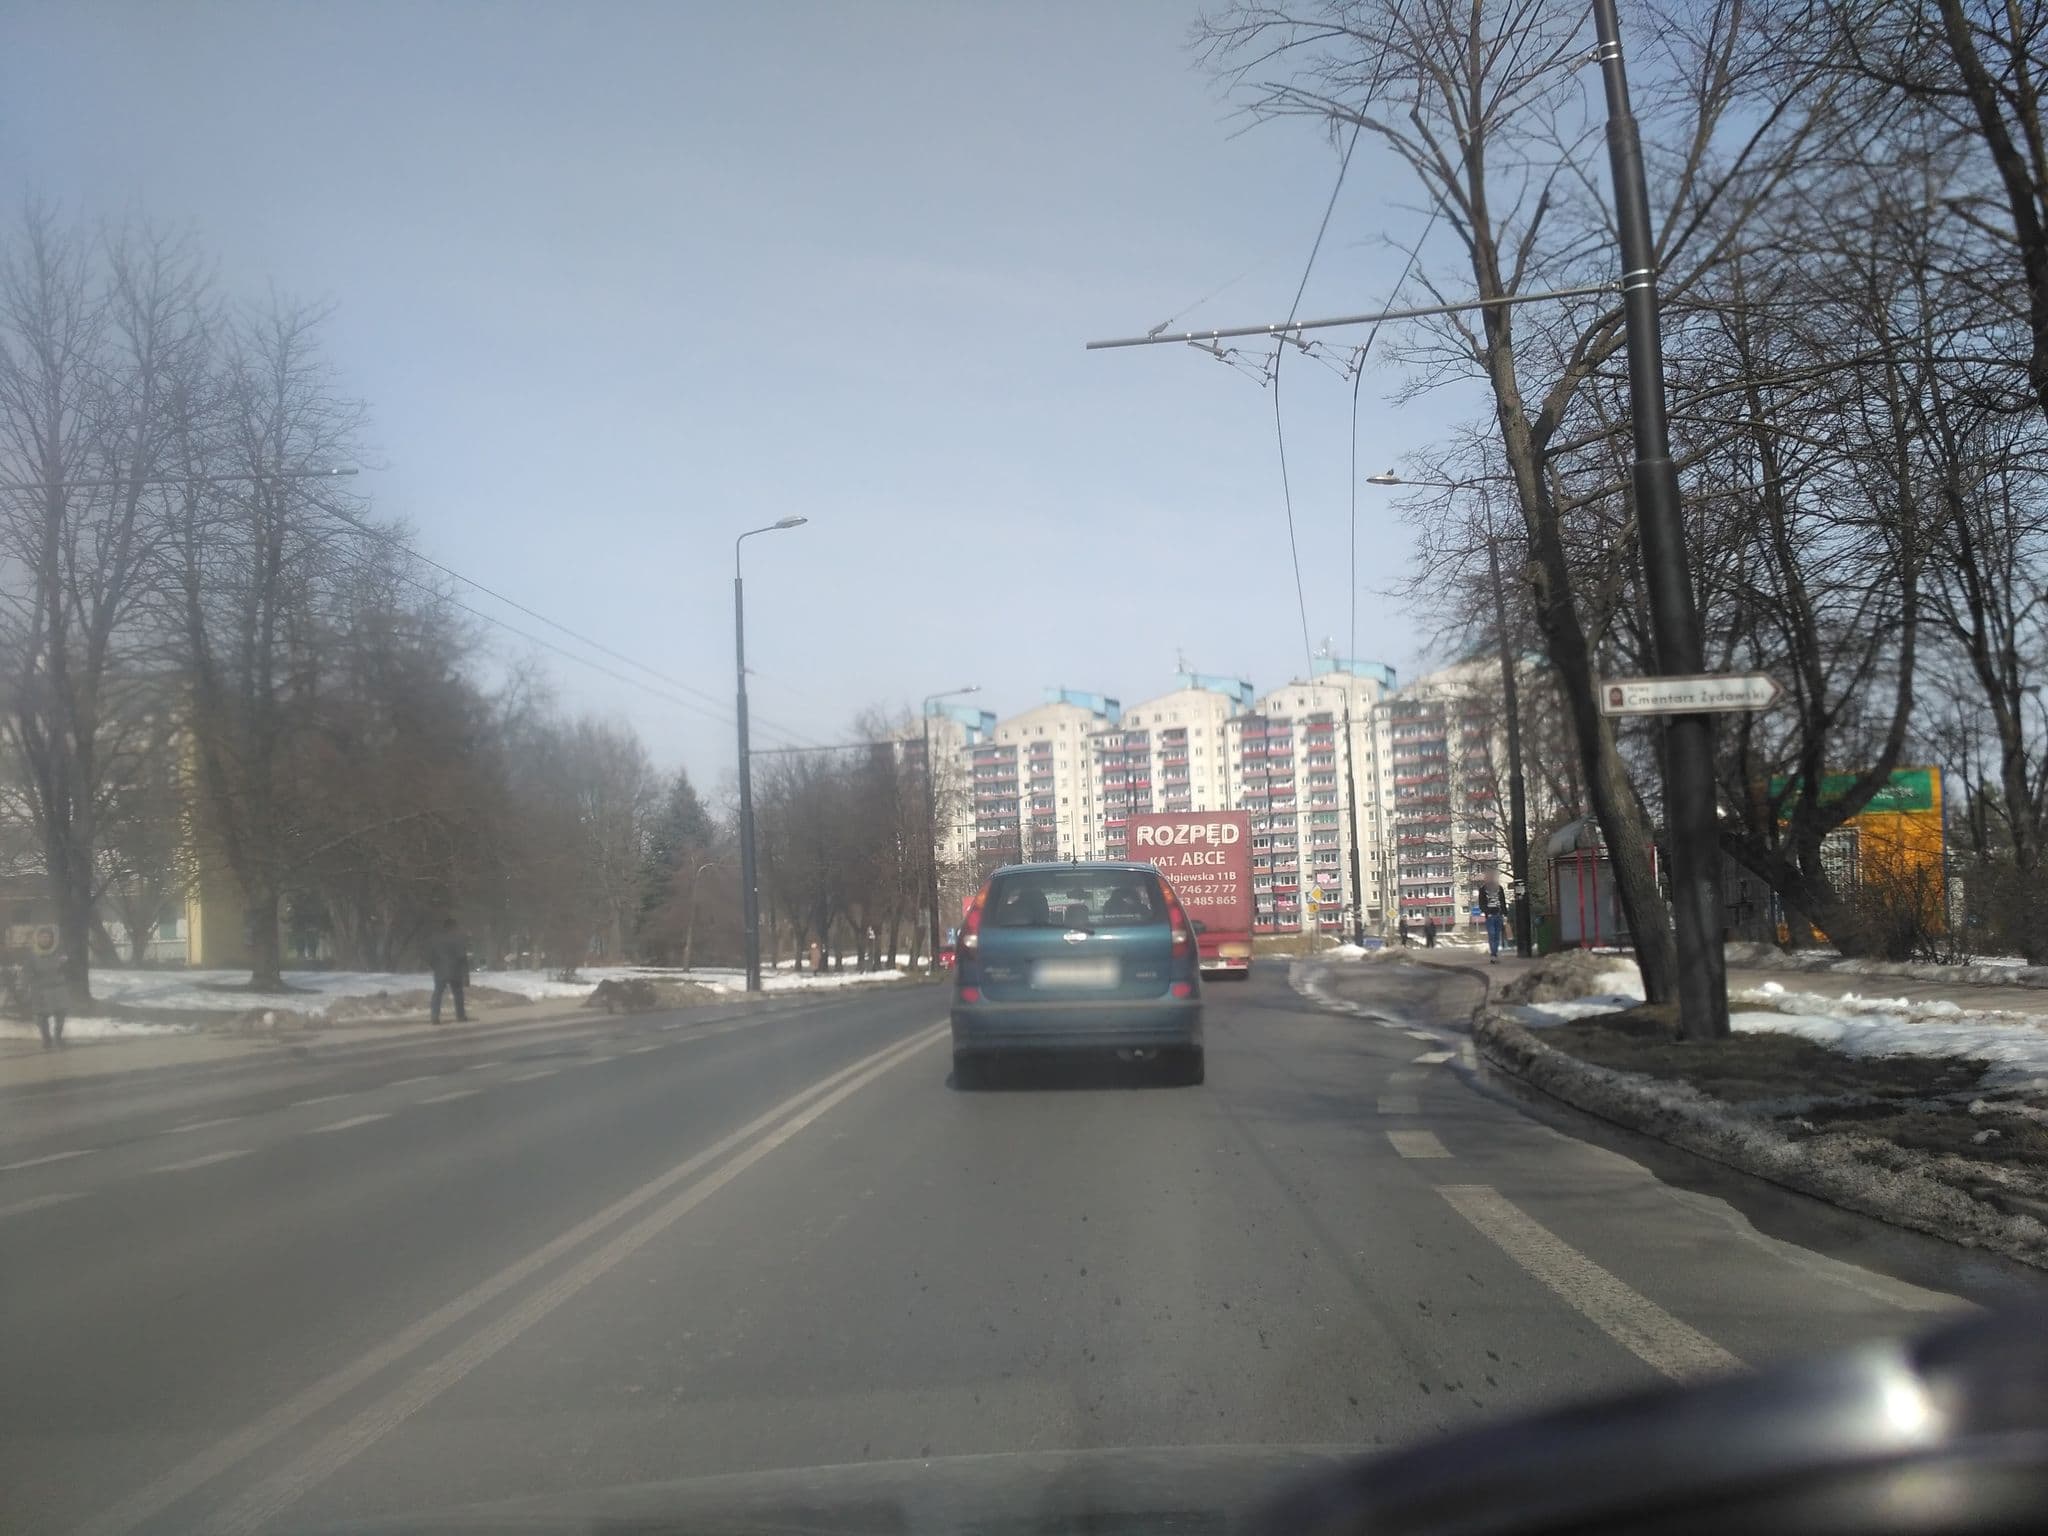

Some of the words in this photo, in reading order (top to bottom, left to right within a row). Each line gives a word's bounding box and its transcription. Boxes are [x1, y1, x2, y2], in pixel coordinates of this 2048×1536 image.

[1627, 693, 1695, 705] Cmentarz
[1137, 824, 1239, 847] ROZPĘD
[1150, 856, 1177, 867] KAT.
[1181, 851, 1226, 866] ABCE
[1165, 872, 1214, 883] elgiewska
[1217, 871, 1237, 881] 11B
[1180, 885, 1202, 895] 746
[1204, 884, 1219, 894] 27
[1222, 884, 1237, 893] 77
[1193, 896, 1214, 906] 485
[1216, 895, 1237, 905] 865
